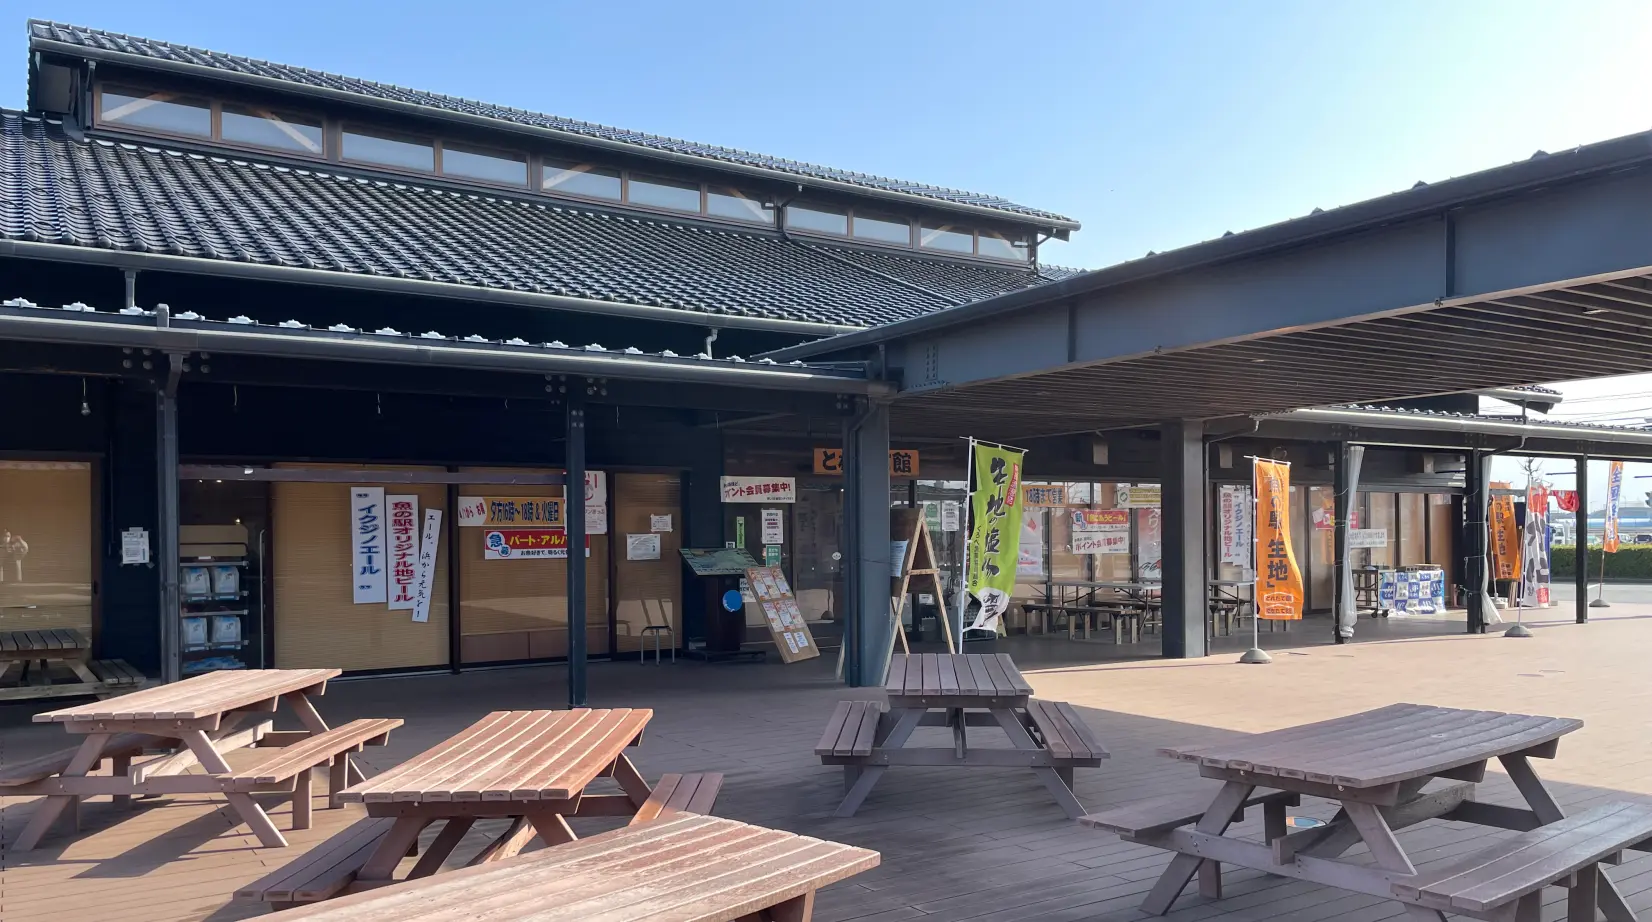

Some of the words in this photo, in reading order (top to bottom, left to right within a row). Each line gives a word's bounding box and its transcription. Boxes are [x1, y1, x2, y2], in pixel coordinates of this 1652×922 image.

[358, 504, 381, 575] イクジノエール
[392, 501, 415, 602] 魚の駅オリジナル地ビール
